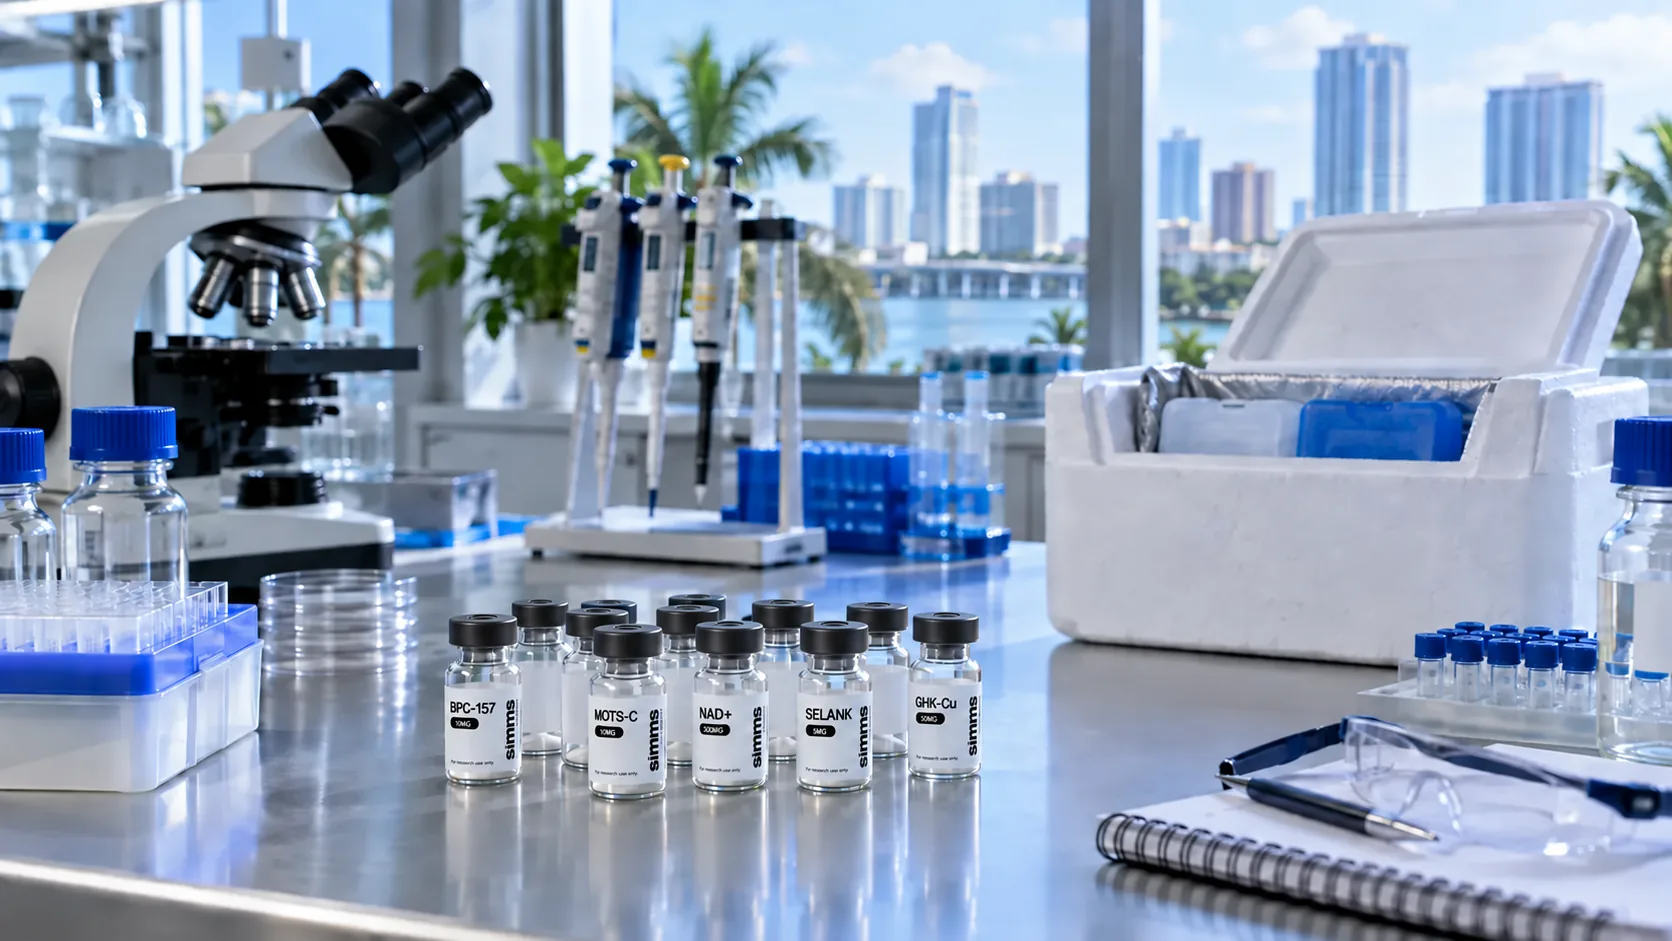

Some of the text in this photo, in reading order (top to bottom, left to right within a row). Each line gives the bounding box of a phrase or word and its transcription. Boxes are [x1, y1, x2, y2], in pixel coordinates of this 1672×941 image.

[450, 701, 496, 714] BPC-157
[594, 709, 638, 722] MOTS-C
[699, 706, 732, 720] NAD+
[806, 708, 852, 720] SELANK
[916, 696, 957, 709] GHK-Cu
[505, 699, 515, 760] simms
[648, 709, 659, 772] simms
[752, 706, 762, 768] simms
[858, 706, 868, 768] simms
[967, 696, 978, 756] simms
